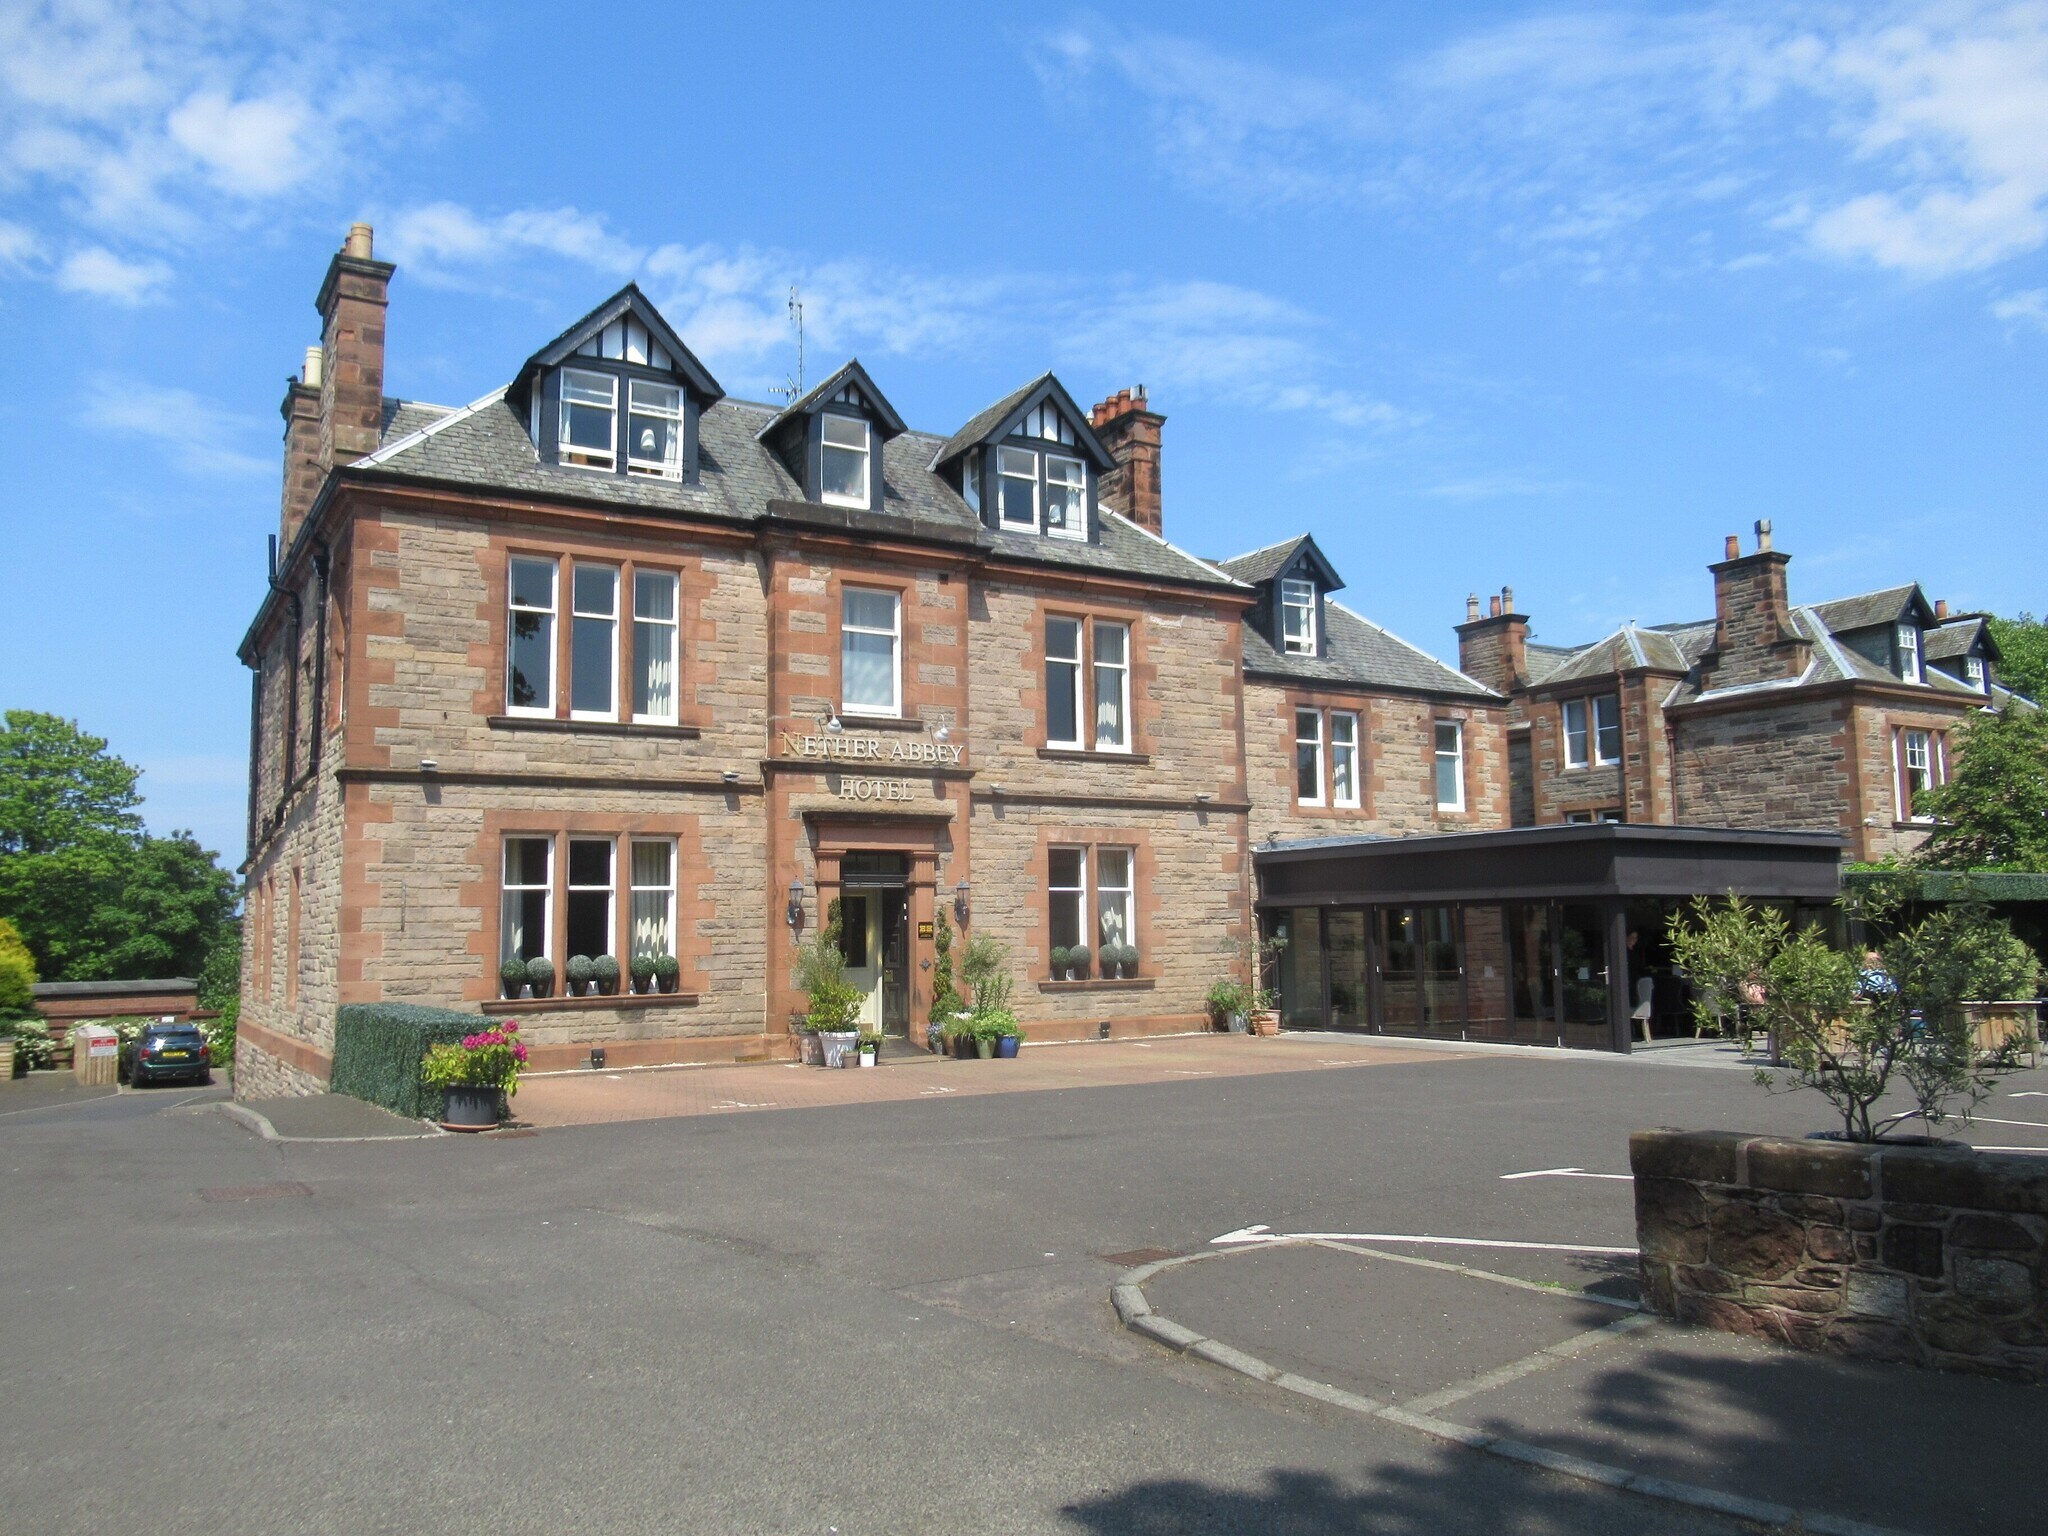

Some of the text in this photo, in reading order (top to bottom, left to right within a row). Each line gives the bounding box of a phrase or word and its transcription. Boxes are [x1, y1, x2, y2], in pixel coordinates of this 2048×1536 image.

[780, 732, 964, 763] NETHER ABBEY
[839, 779, 915, 801] HOTEL
